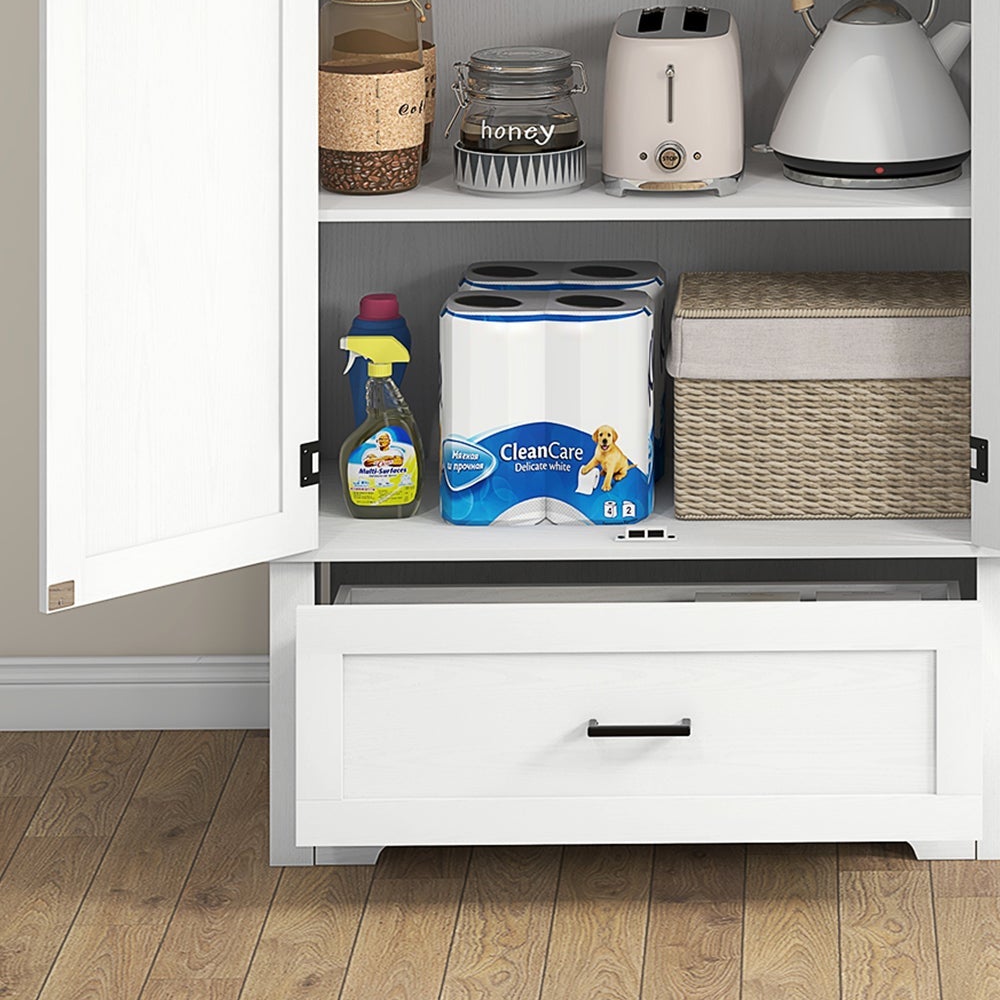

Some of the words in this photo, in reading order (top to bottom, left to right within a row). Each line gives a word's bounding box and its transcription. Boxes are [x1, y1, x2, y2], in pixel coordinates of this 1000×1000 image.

[481, 119, 555, 145] honey
[500, 441, 584, 461] CleanCare
[358, 467, 407, 475] Multi-Surfaces
[514, 461, 547, 473] Delicate
[549, 462, 571, 473] white
[606, 507, 613, 516] 4
[625, 506, 632, 515] 2
